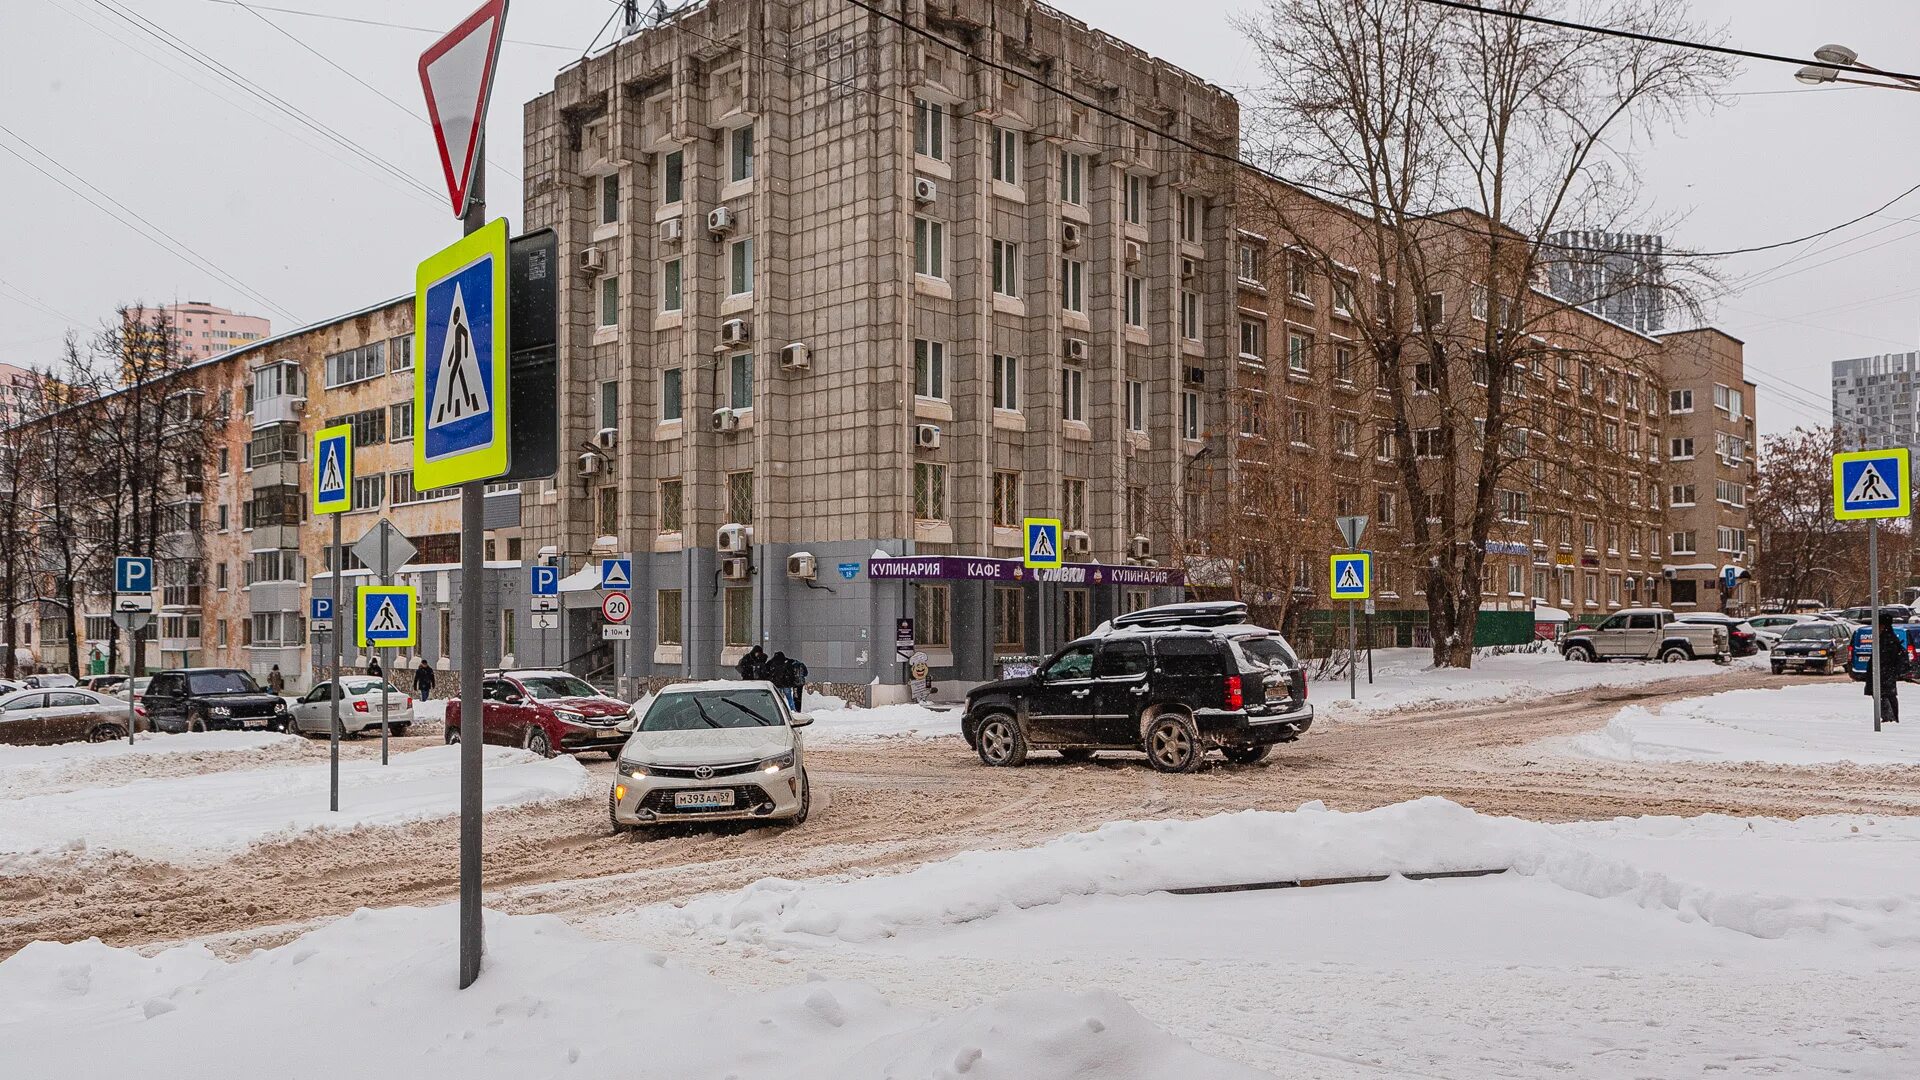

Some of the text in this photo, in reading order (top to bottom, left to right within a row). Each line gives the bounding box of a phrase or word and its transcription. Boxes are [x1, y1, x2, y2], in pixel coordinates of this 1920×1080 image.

[127, 561, 145, 588] P
[538, 569, 554, 592] P
[871, 563, 940, 576] КУЛИНАРИЯ
[967, 563, 1001, 577] КАФЕ
[1112, 569, 1168, 583] КУЛИНАРИЯ
[317, 600, 329, 617] P
[609, 601, 625, 613] 20
[720, 792, 730, 800] 59
